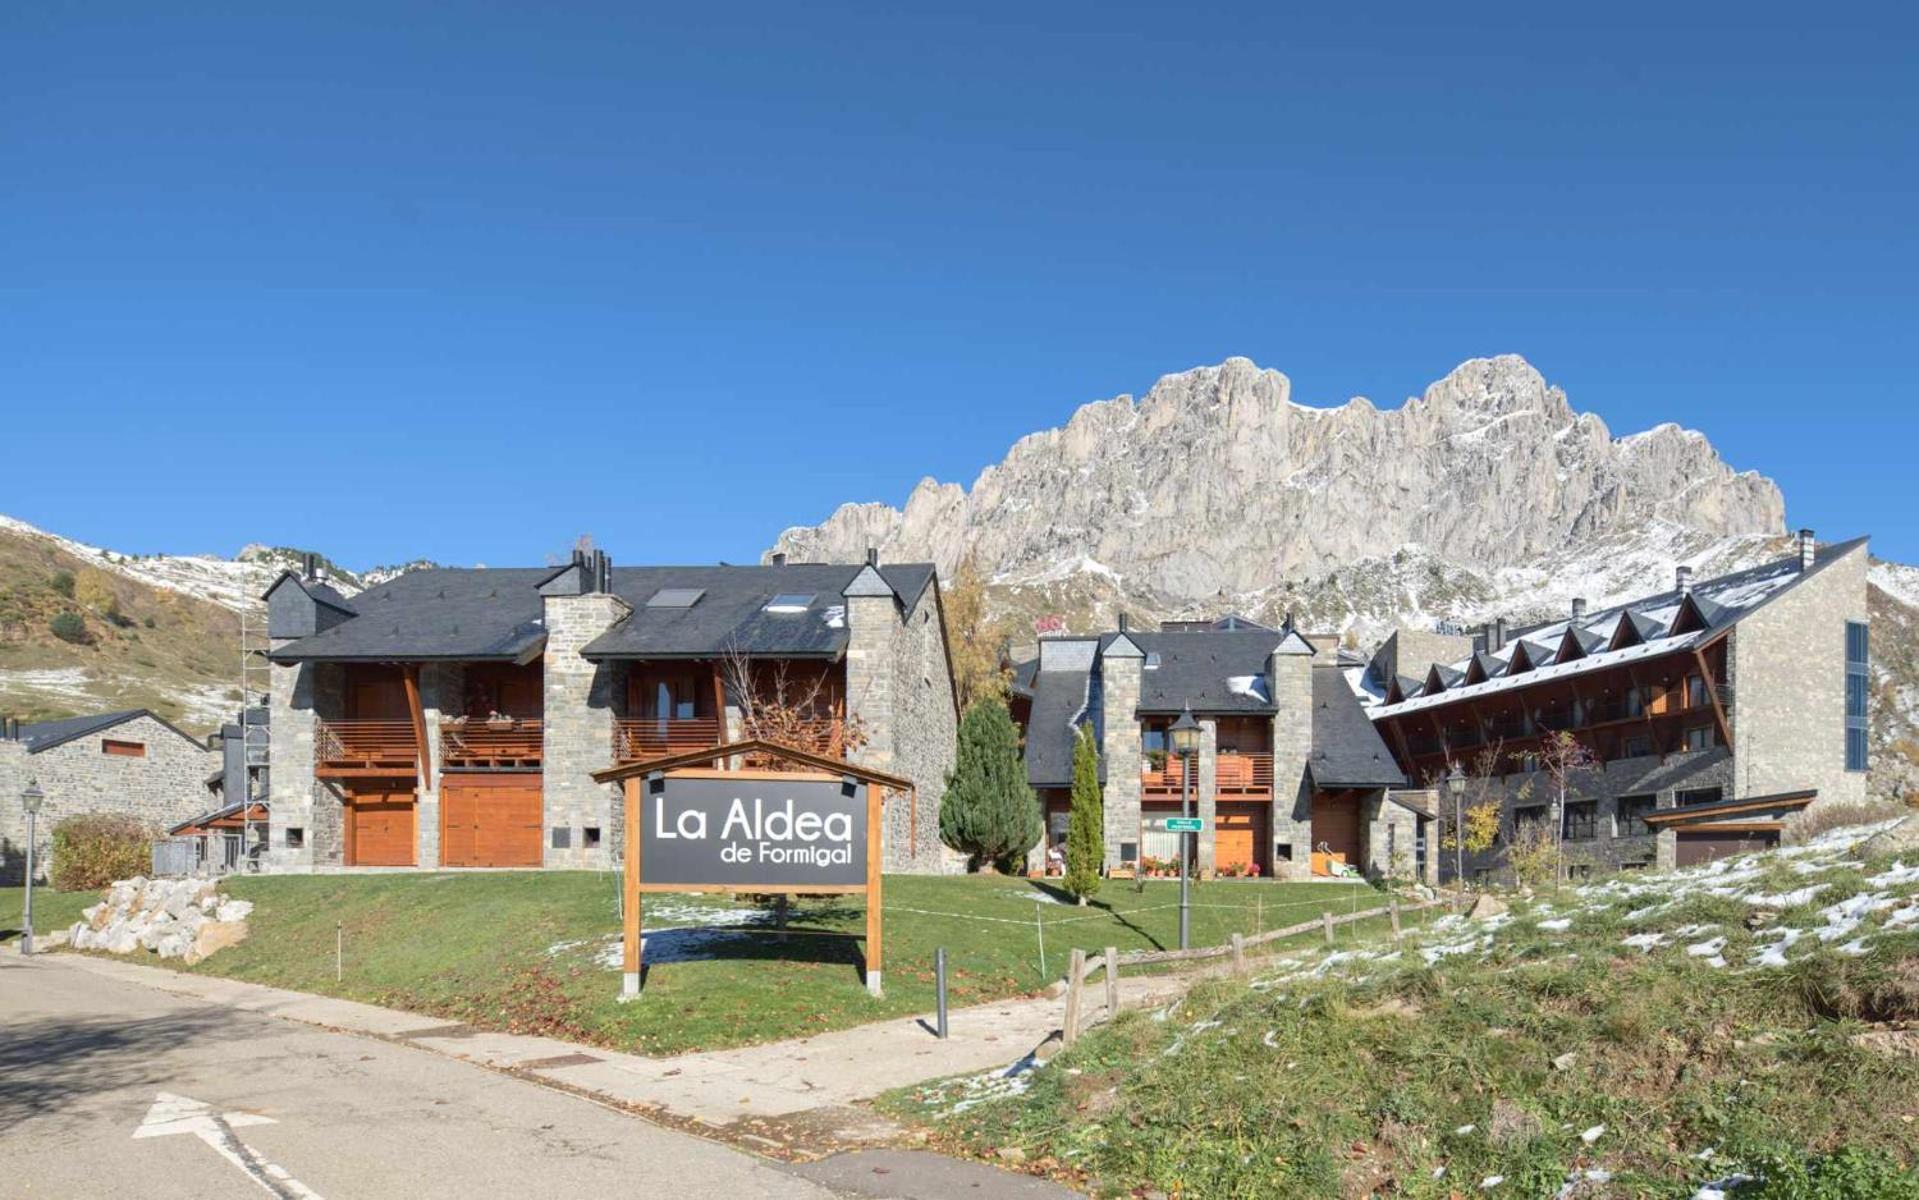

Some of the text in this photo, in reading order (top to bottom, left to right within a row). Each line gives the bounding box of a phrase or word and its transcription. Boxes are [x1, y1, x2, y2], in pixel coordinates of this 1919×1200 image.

[656, 797, 852, 842] La Aldea
[720, 841, 852, 867] de Formigal
